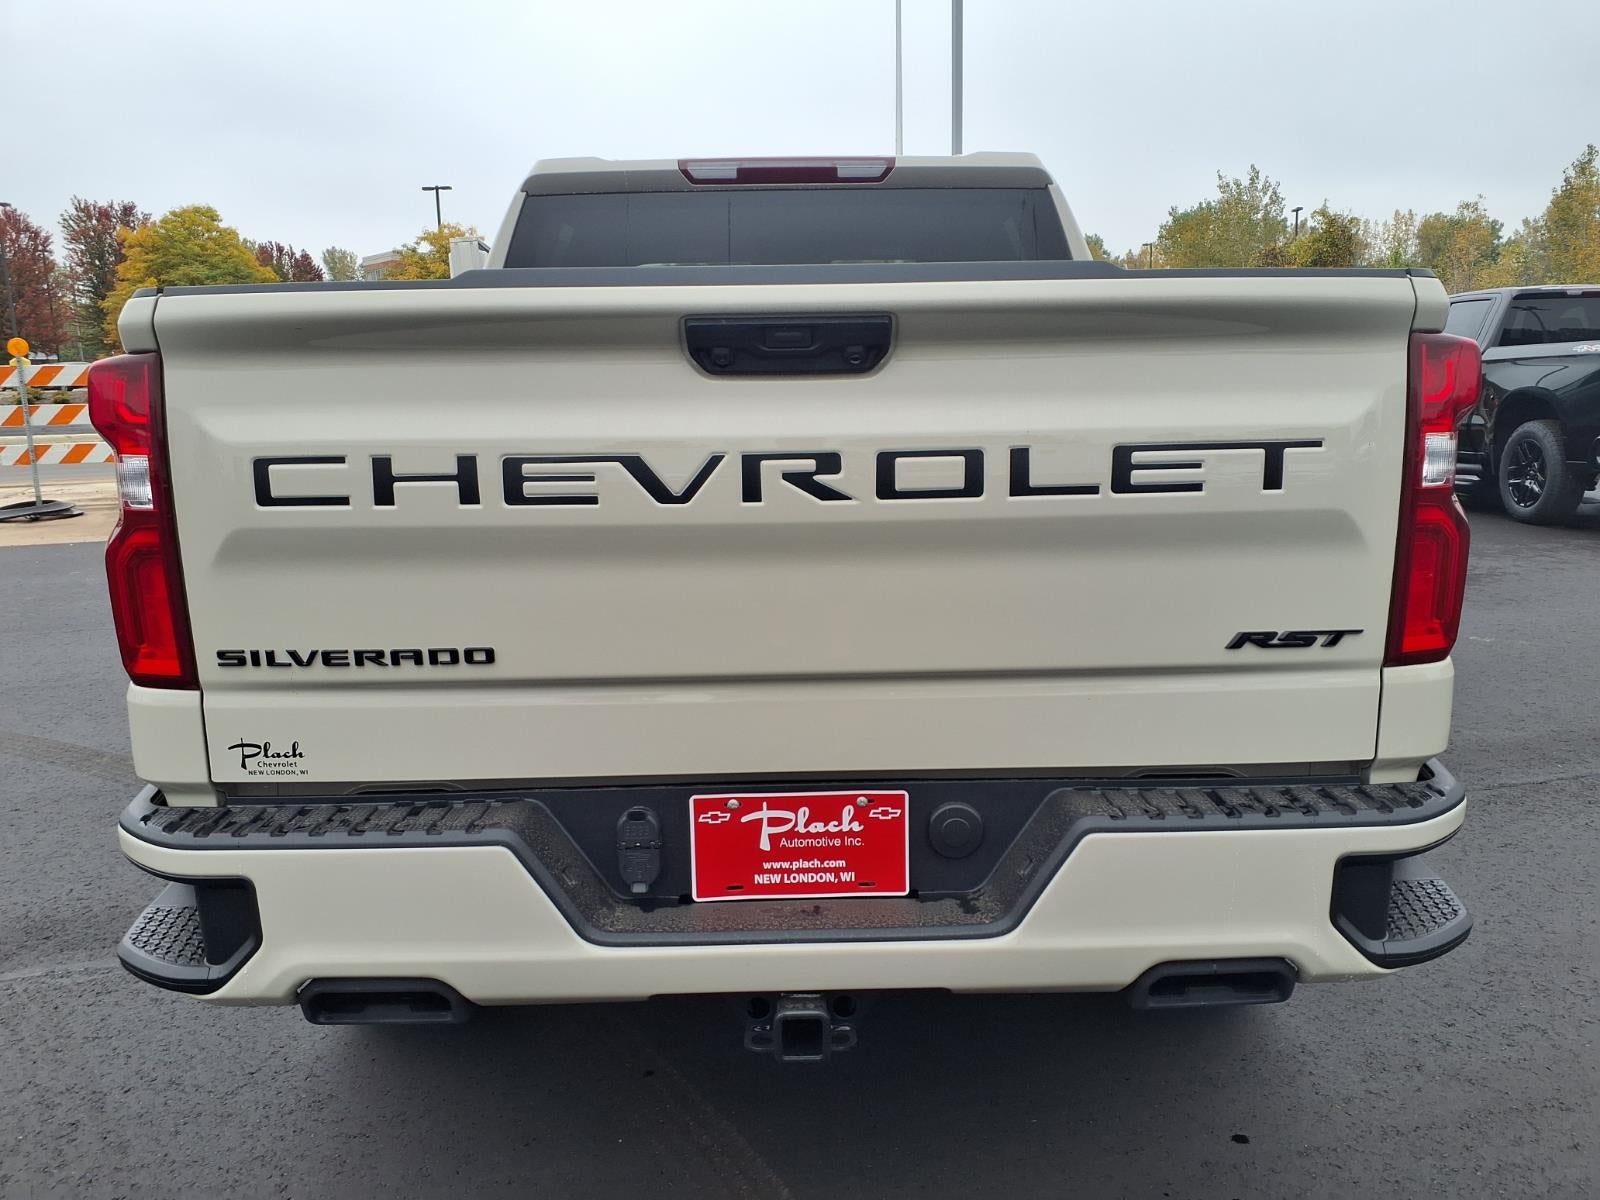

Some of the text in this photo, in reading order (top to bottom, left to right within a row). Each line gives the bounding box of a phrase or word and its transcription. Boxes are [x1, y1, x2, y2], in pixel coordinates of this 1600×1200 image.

[253, 439, 1323, 505] CHEVROLET
[1225, 628, 1364, 649] RST
[216, 646, 496, 667] SILVERADO
[228, 737, 305, 770] Plach
[257, 760, 298, 768] Chevrolet
[740, 801, 864, 851] Plach
[779, 836, 865, 848] Automotive Inc.
[762, 858, 846, 871] www.plach.com
[754, 871, 855, 884] NEW LONDON, WI
